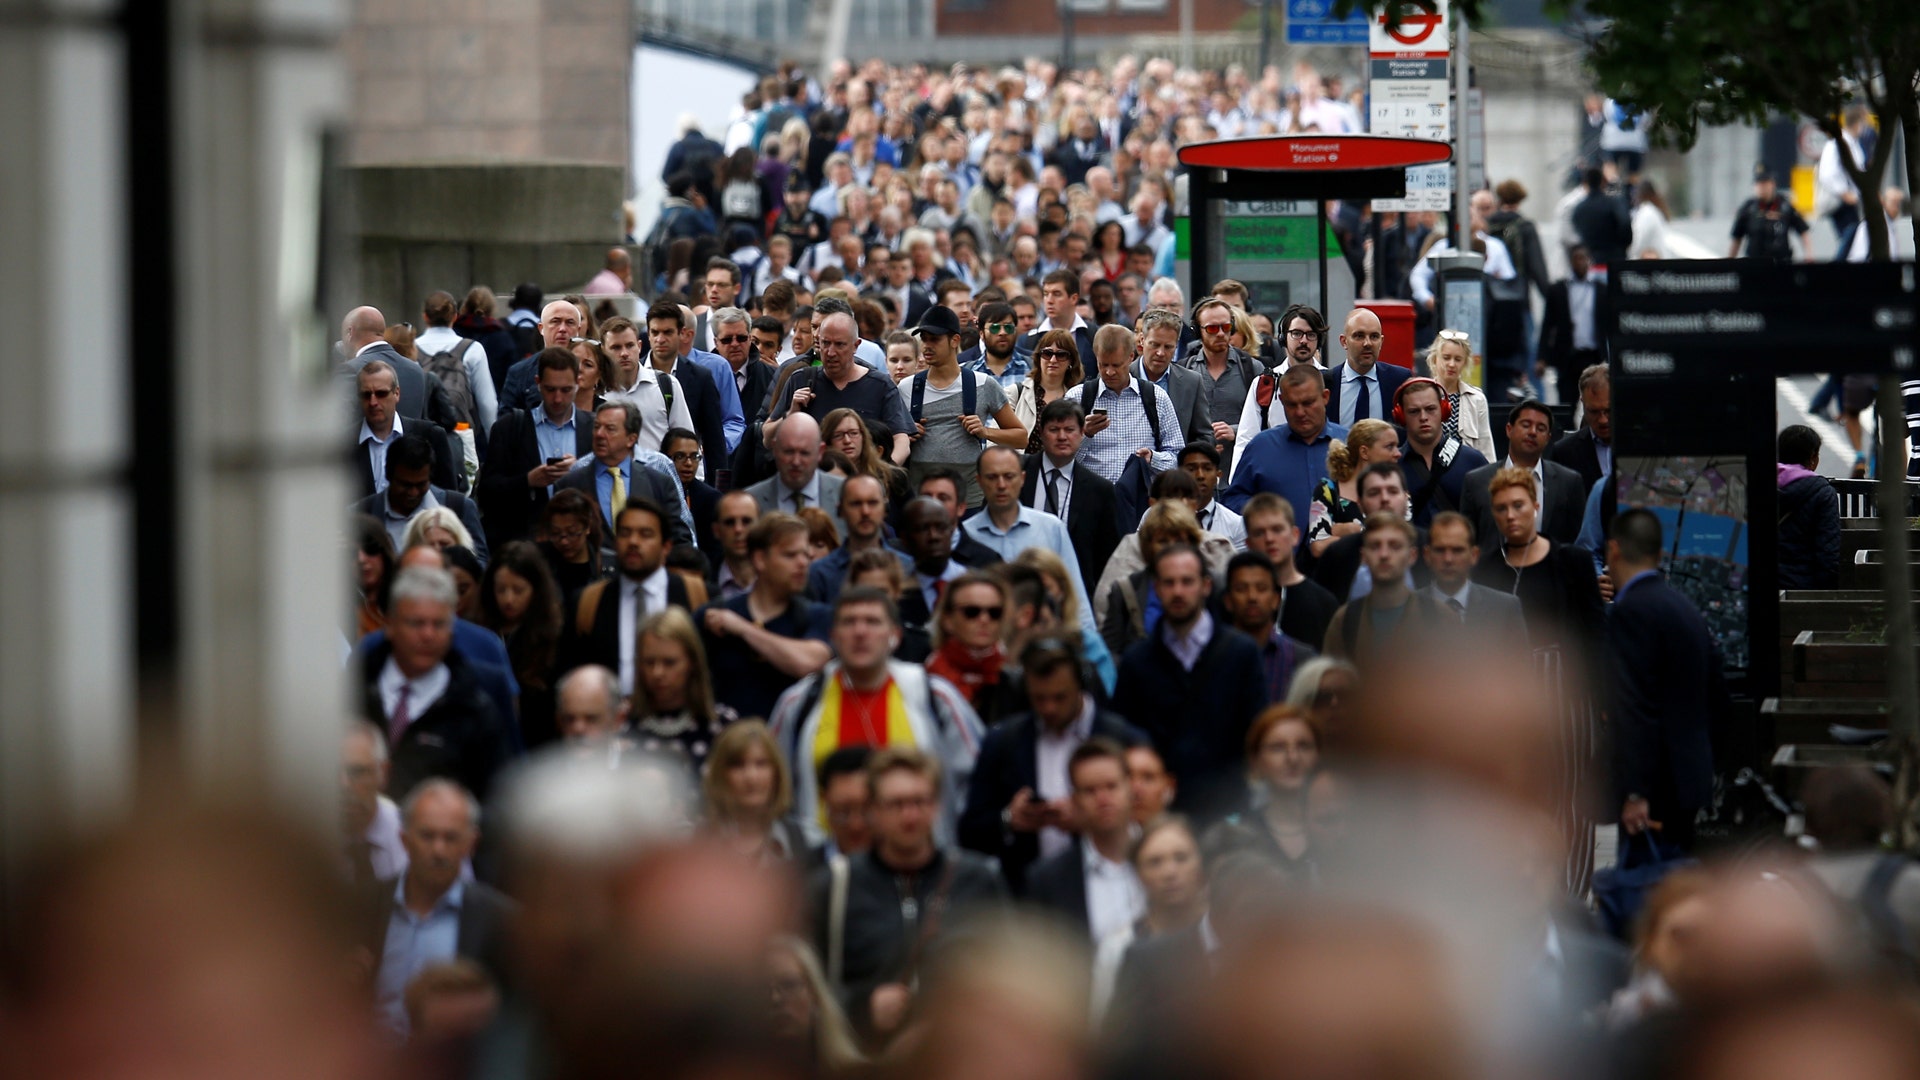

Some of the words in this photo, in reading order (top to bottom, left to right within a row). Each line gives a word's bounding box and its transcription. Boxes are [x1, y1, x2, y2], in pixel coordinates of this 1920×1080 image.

[1389, 60, 1429, 69] Monument
[1392, 69, 1416, 77] Station
[1378, 108, 1388, 117] 17
[1405, 108, 1415, 117] 21
[1289, 143, 1341, 153] Monument
[1293, 154, 1326, 164] Station
[1248, 199, 1298, 213] Cash
[1651, 271, 1740, 293] Monument
[1619, 312, 1704, 333] Monument
